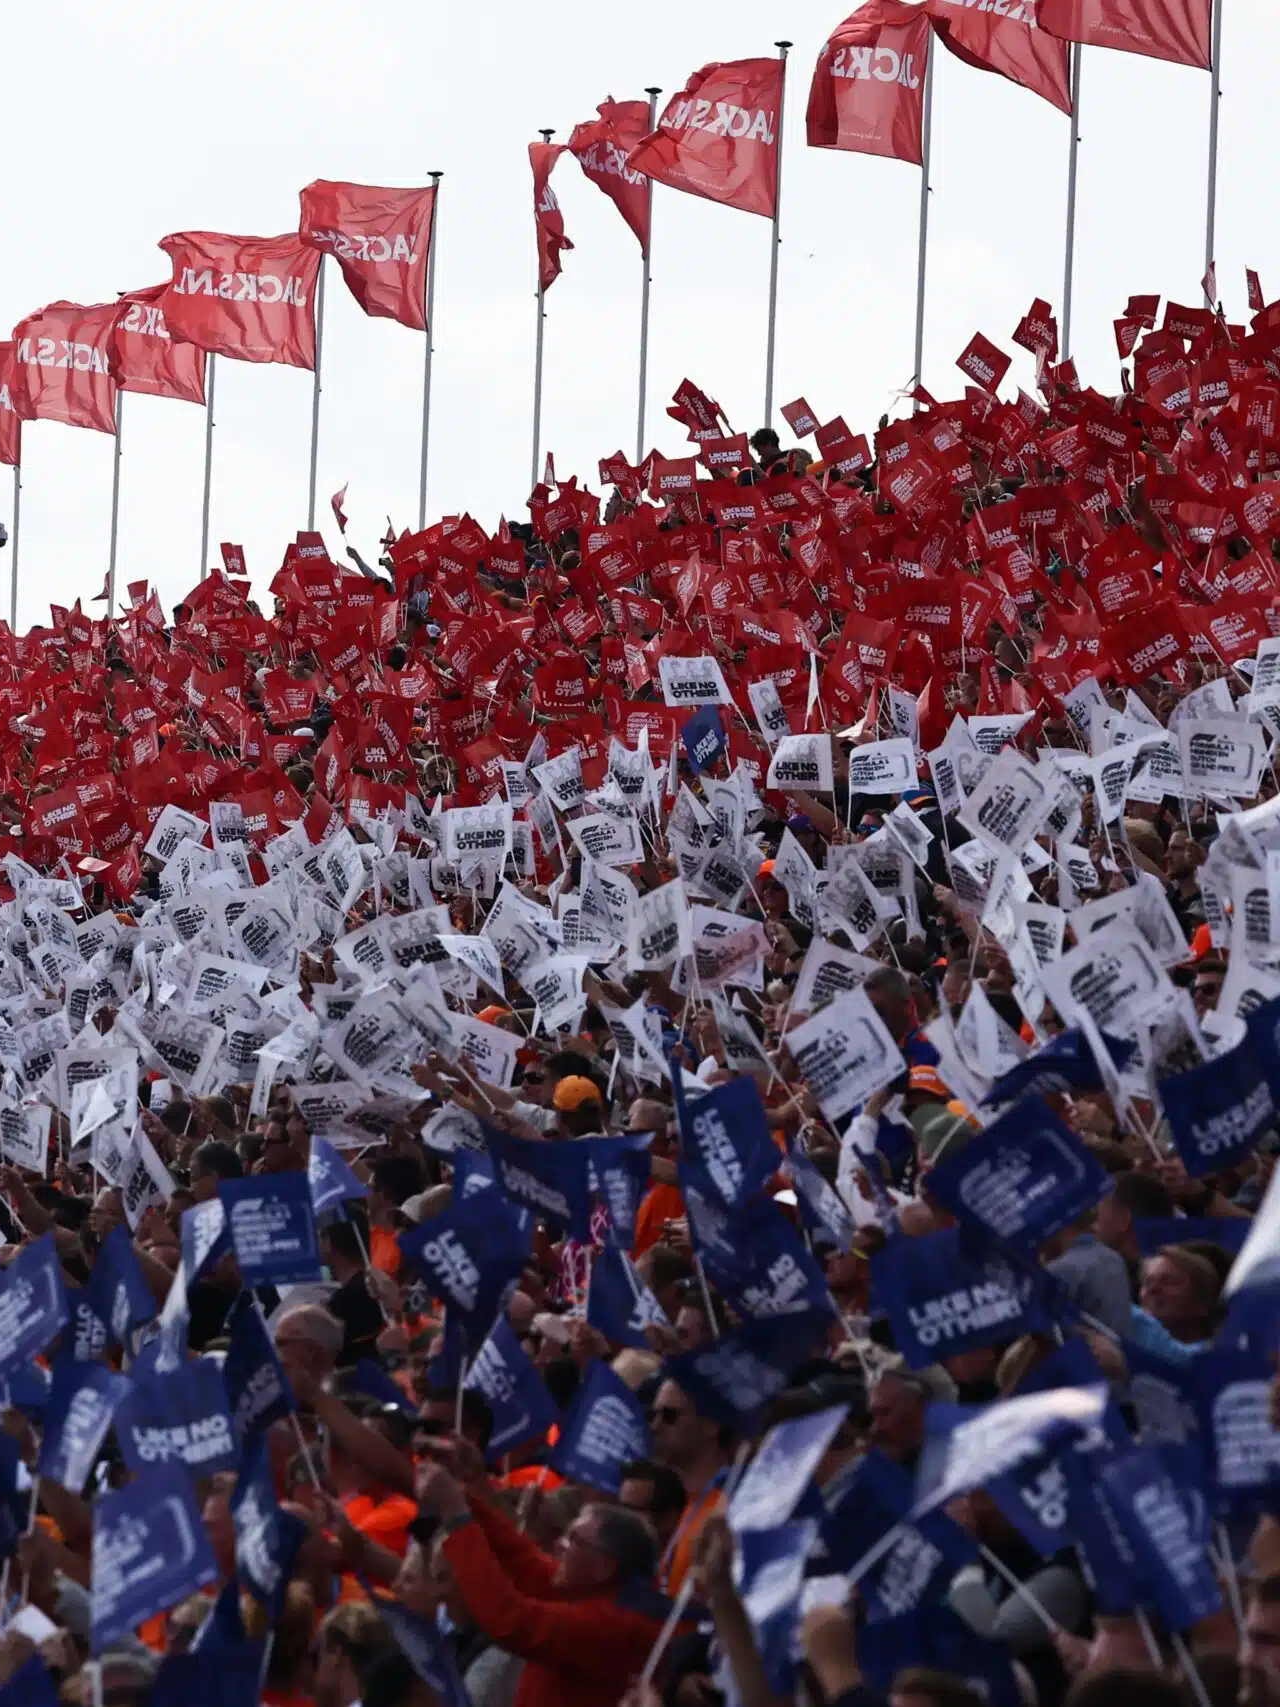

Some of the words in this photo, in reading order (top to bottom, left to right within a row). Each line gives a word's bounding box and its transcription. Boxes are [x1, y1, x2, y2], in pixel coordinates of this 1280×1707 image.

[1127, 644, 1157, 667] LIKE
[1154, 633, 1175, 650] NO
[670, 682, 697, 691] LIKE
[698, 681, 717, 690] NO
[776, 762, 799, 771] LIKE
[800, 762, 819, 771] NO
[456, 831, 485, 841] LIKE
[486, 830, 506, 839] NO
